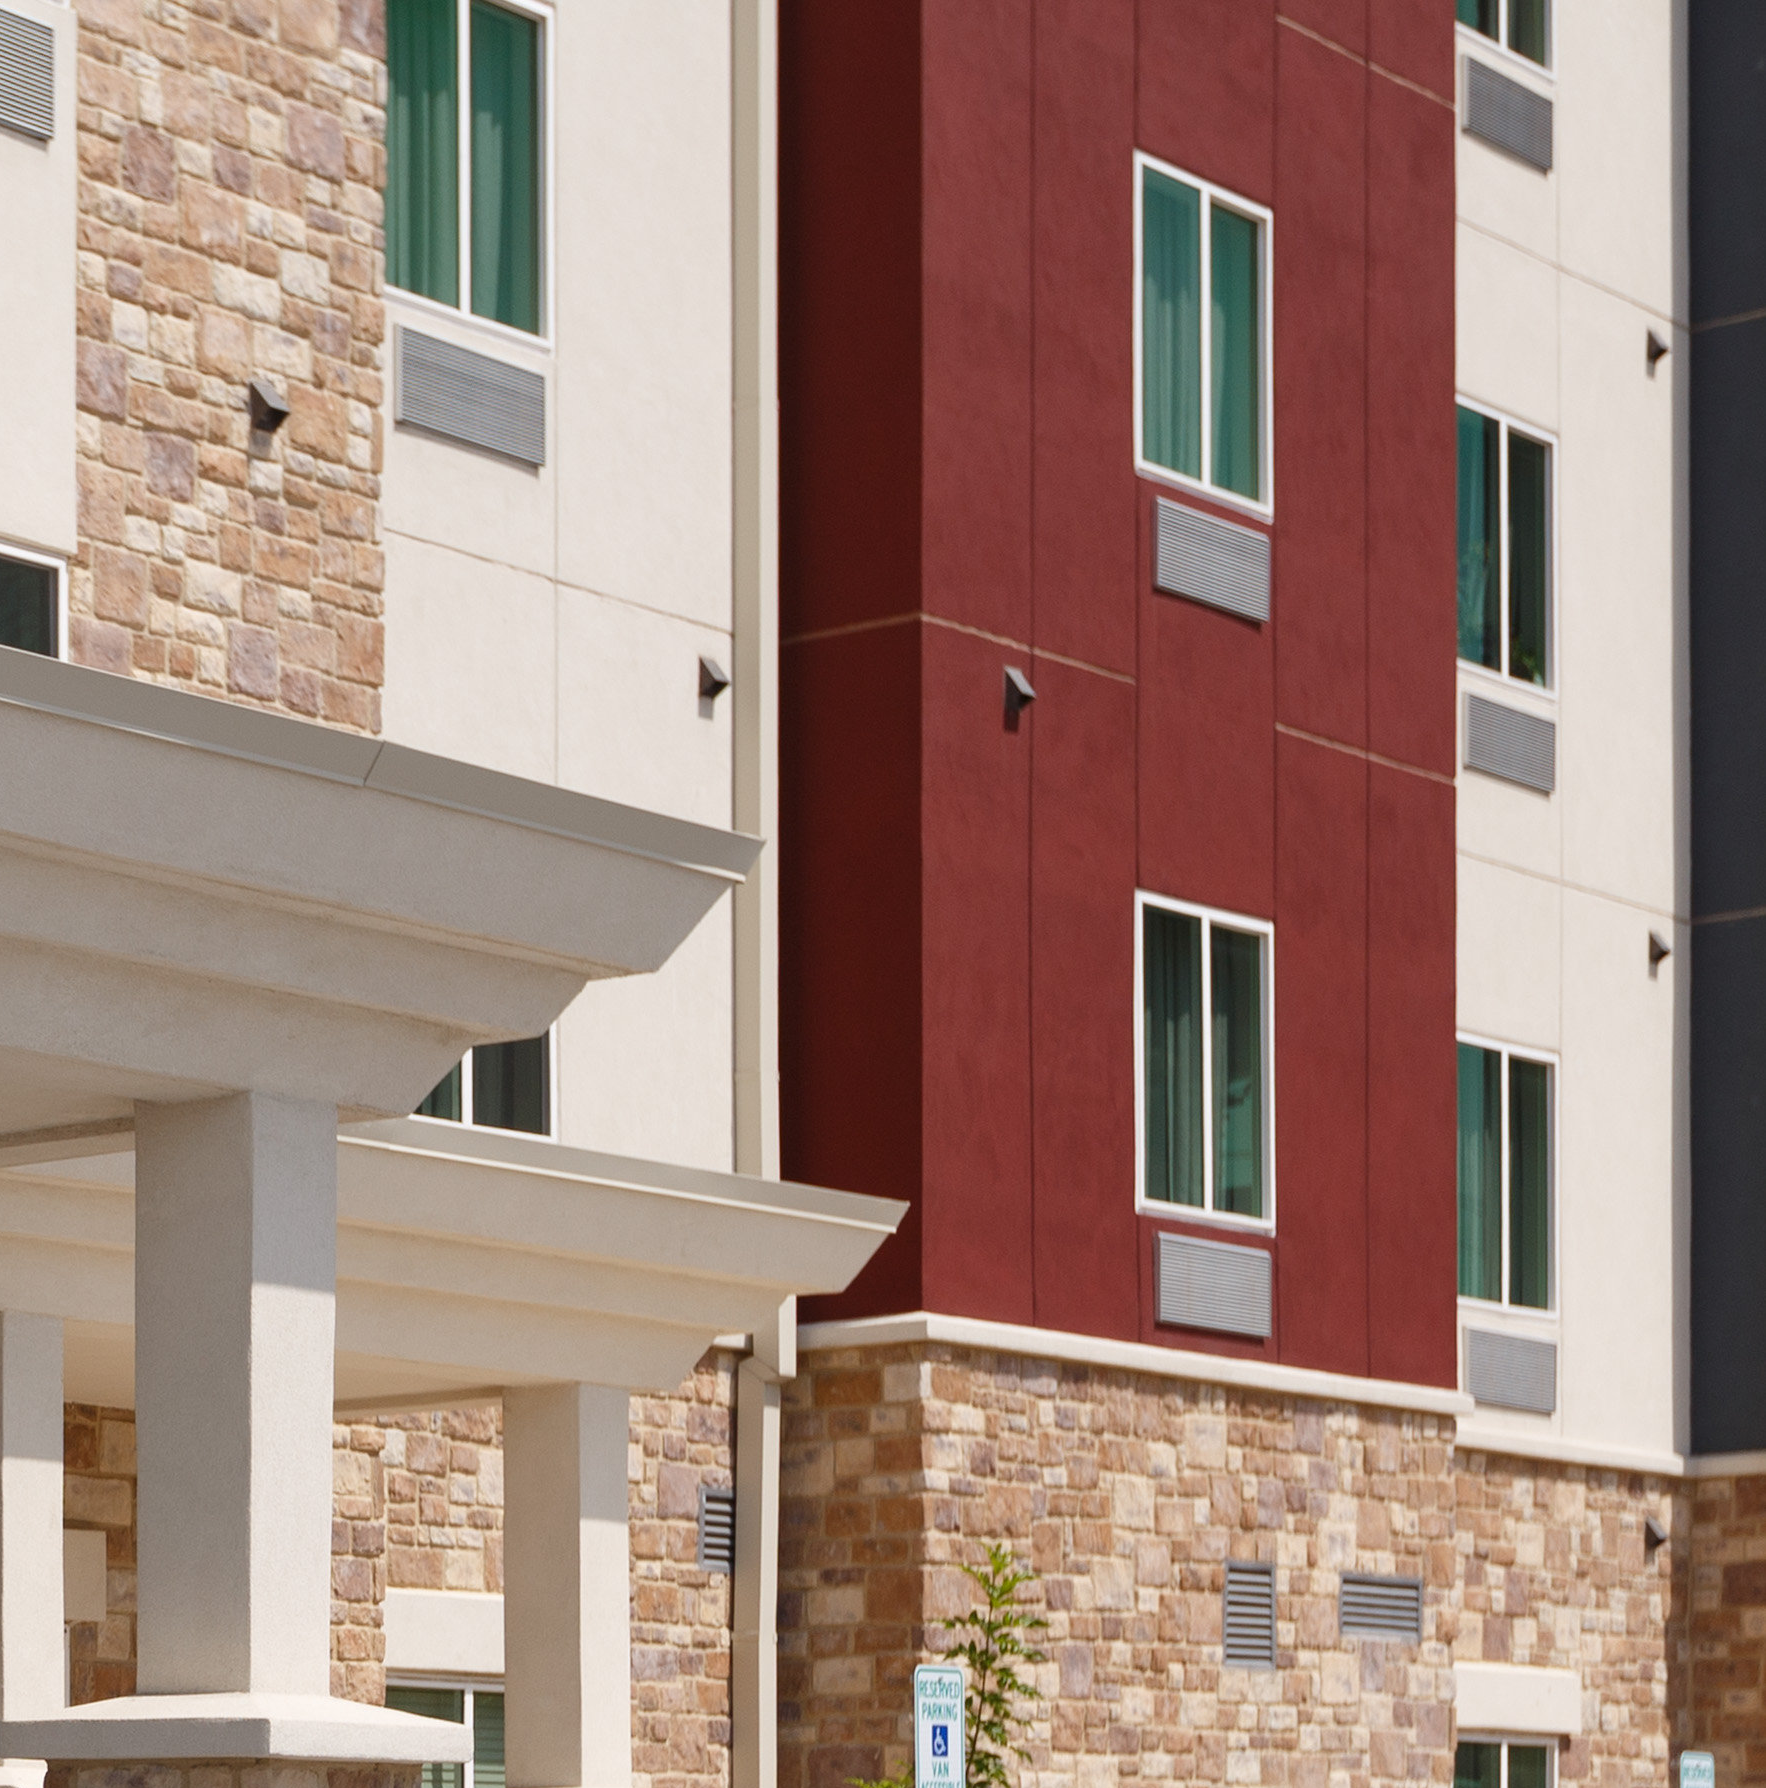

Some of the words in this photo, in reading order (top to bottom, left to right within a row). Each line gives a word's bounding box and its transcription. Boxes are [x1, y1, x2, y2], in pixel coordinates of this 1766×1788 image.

[919, 1680, 960, 1699] RESERVED
[921, 1702, 958, 1722] PARKING
[931, 1761, 949, 1777] VAN
